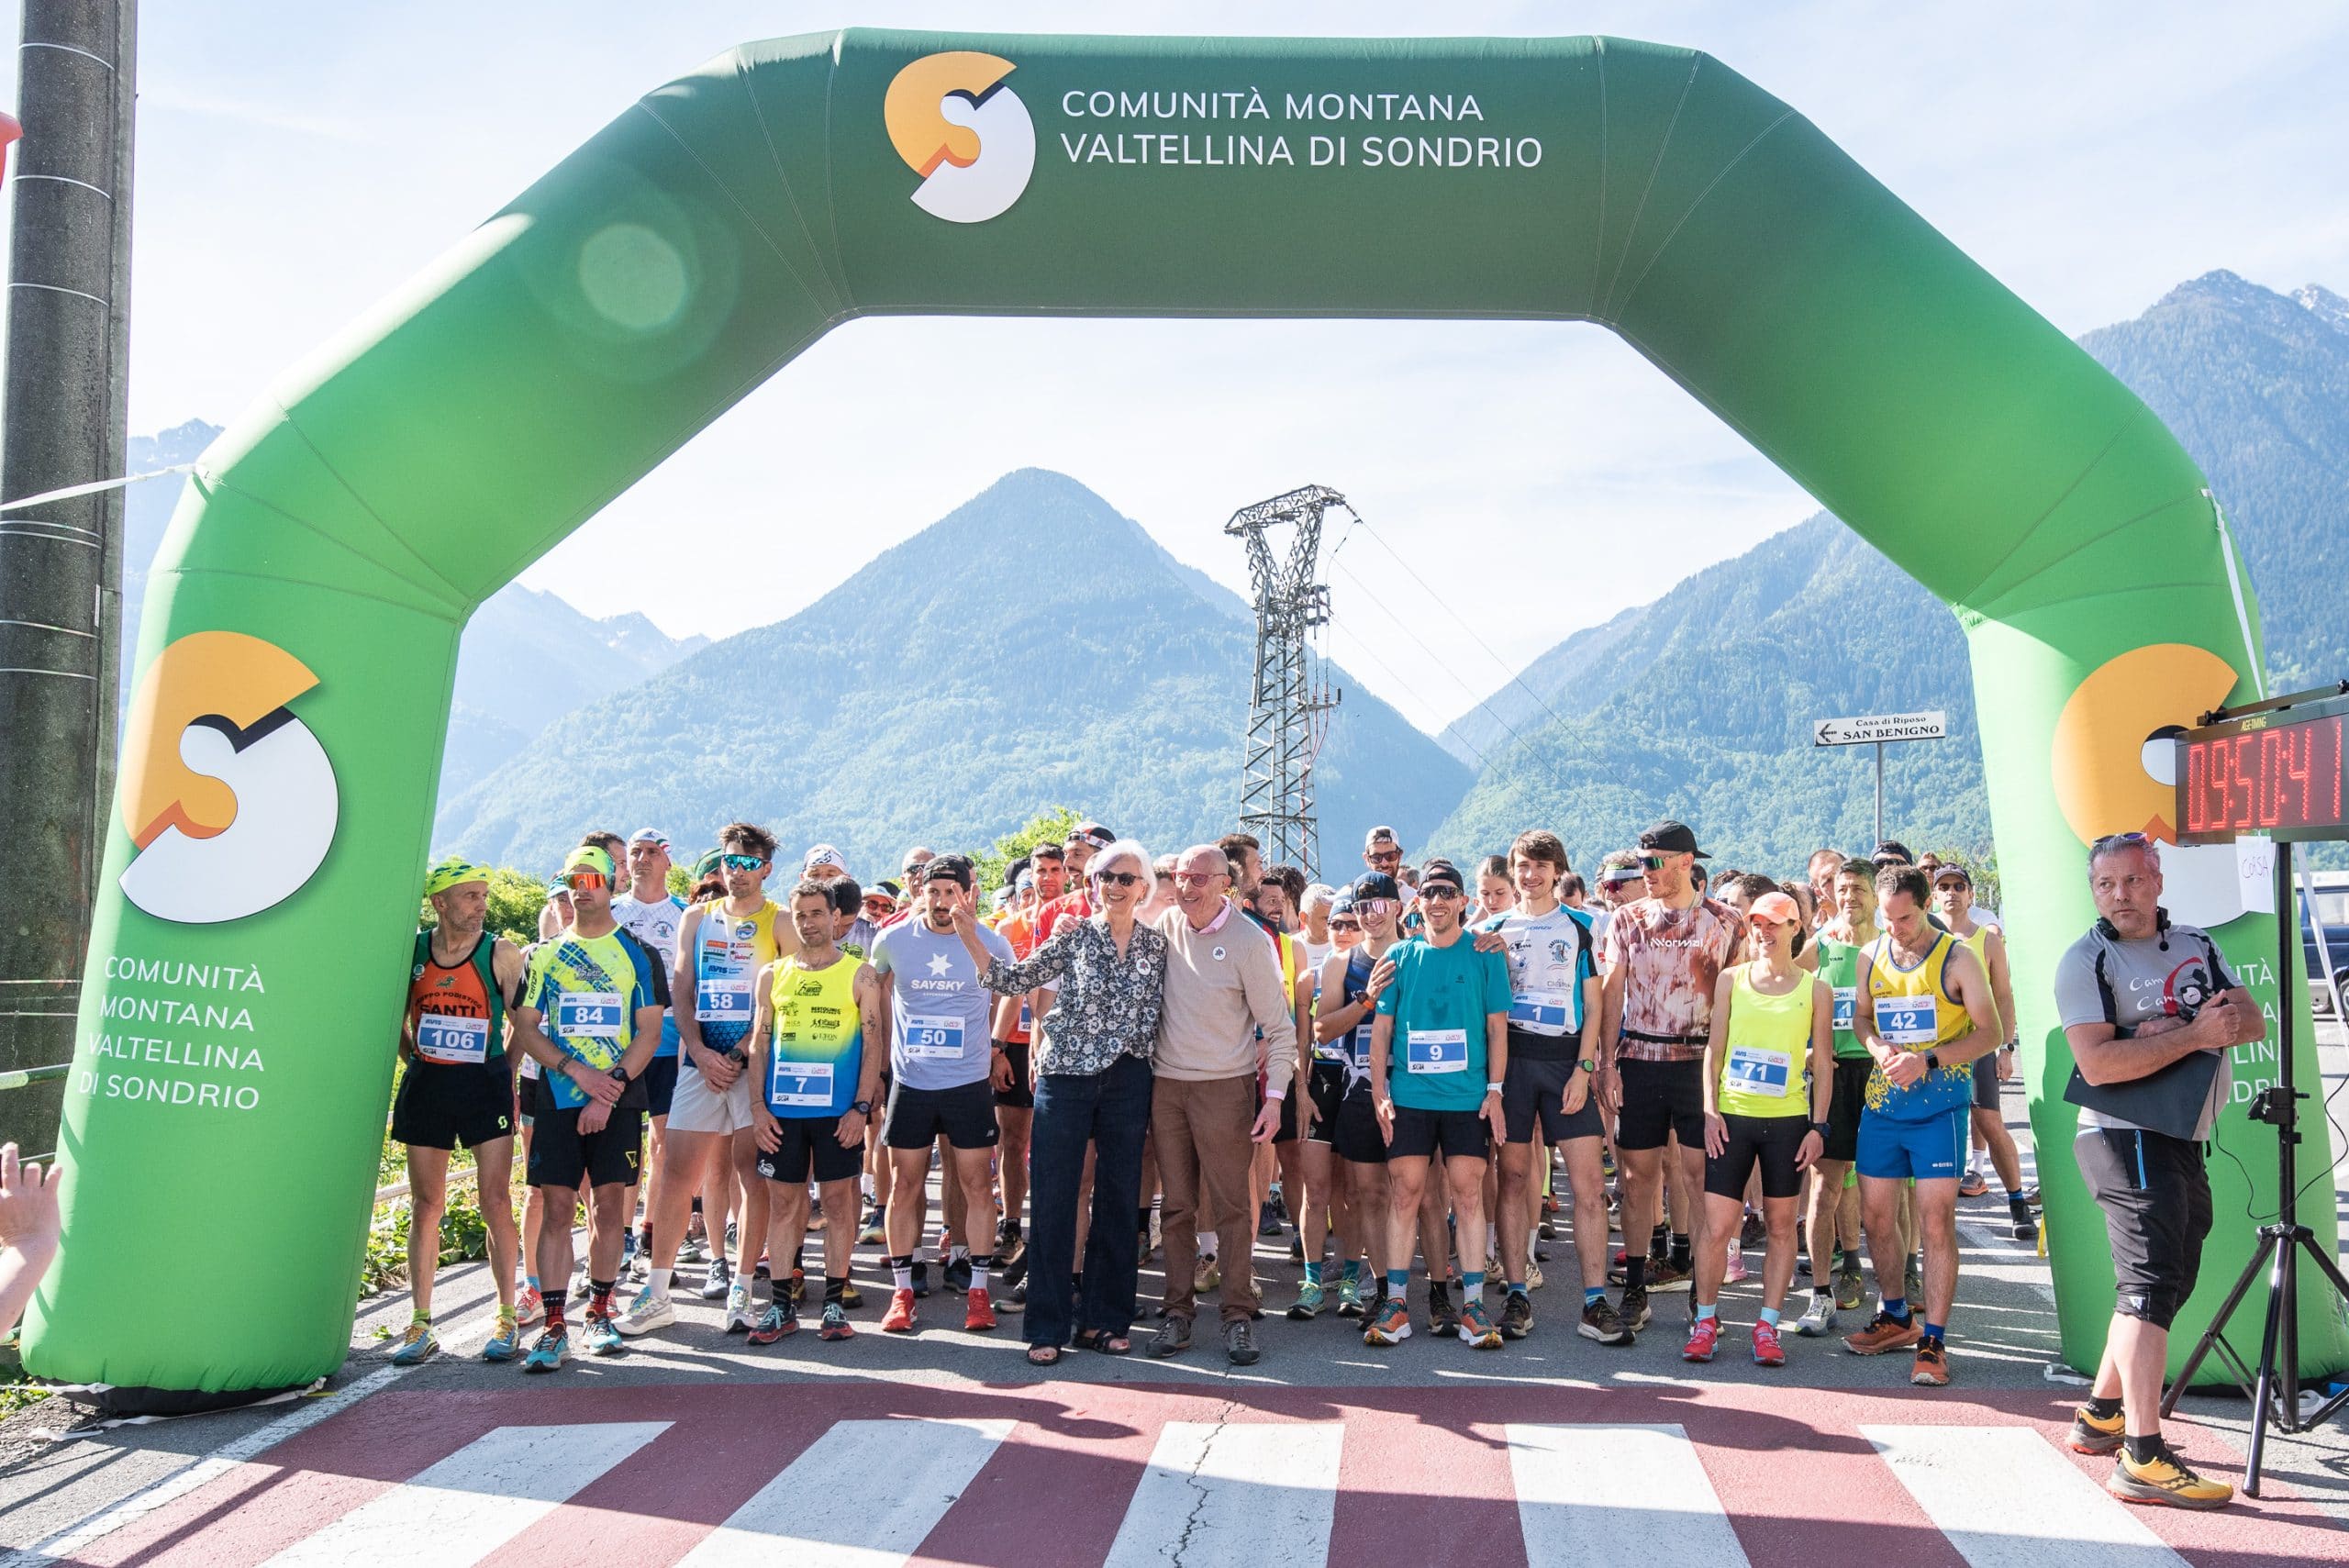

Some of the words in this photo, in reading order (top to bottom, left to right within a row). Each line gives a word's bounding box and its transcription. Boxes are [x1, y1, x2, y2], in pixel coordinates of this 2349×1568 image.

[1062, 86, 1270, 119] COMUNITÀ
[1286, 94, 1484, 121] MONTANA
[1061, 133, 1295, 166] VALTELLINA
[1310, 136, 1346, 167] DI
[1362, 136, 1542, 168] SONDRIO
[1893, 716, 1927, 725] Riposo
[1842, 729, 1871, 740] SAN
[1876, 725, 1940, 738] BENIGNO
[105, 956, 265, 994] COMUNITÀ
[910, 979, 965, 991] SAYSKY
[442, 992, 483, 1009] PODISTICO
[710, 994, 733, 1009] 58
[99, 995, 254, 1032] MONTANA
[419, 1004, 476, 1018] SANTI
[574, 1006, 604, 1024] 84
[1531, 1006, 1542, 1022] 1
[1890, 1011, 1918, 1030] 42
[431, 1029, 475, 1050] 106
[920, 1029, 947, 1046] 50
[89, 1032, 264, 1072] VALTELLINA
[1429, 1044, 1443, 1062] 9
[1743, 1062, 1767, 1082] 71
[79, 1071, 99, 1095] DI
[106, 1073, 260, 1110] SONDRIO
[795, 1076, 807, 1094] 7
